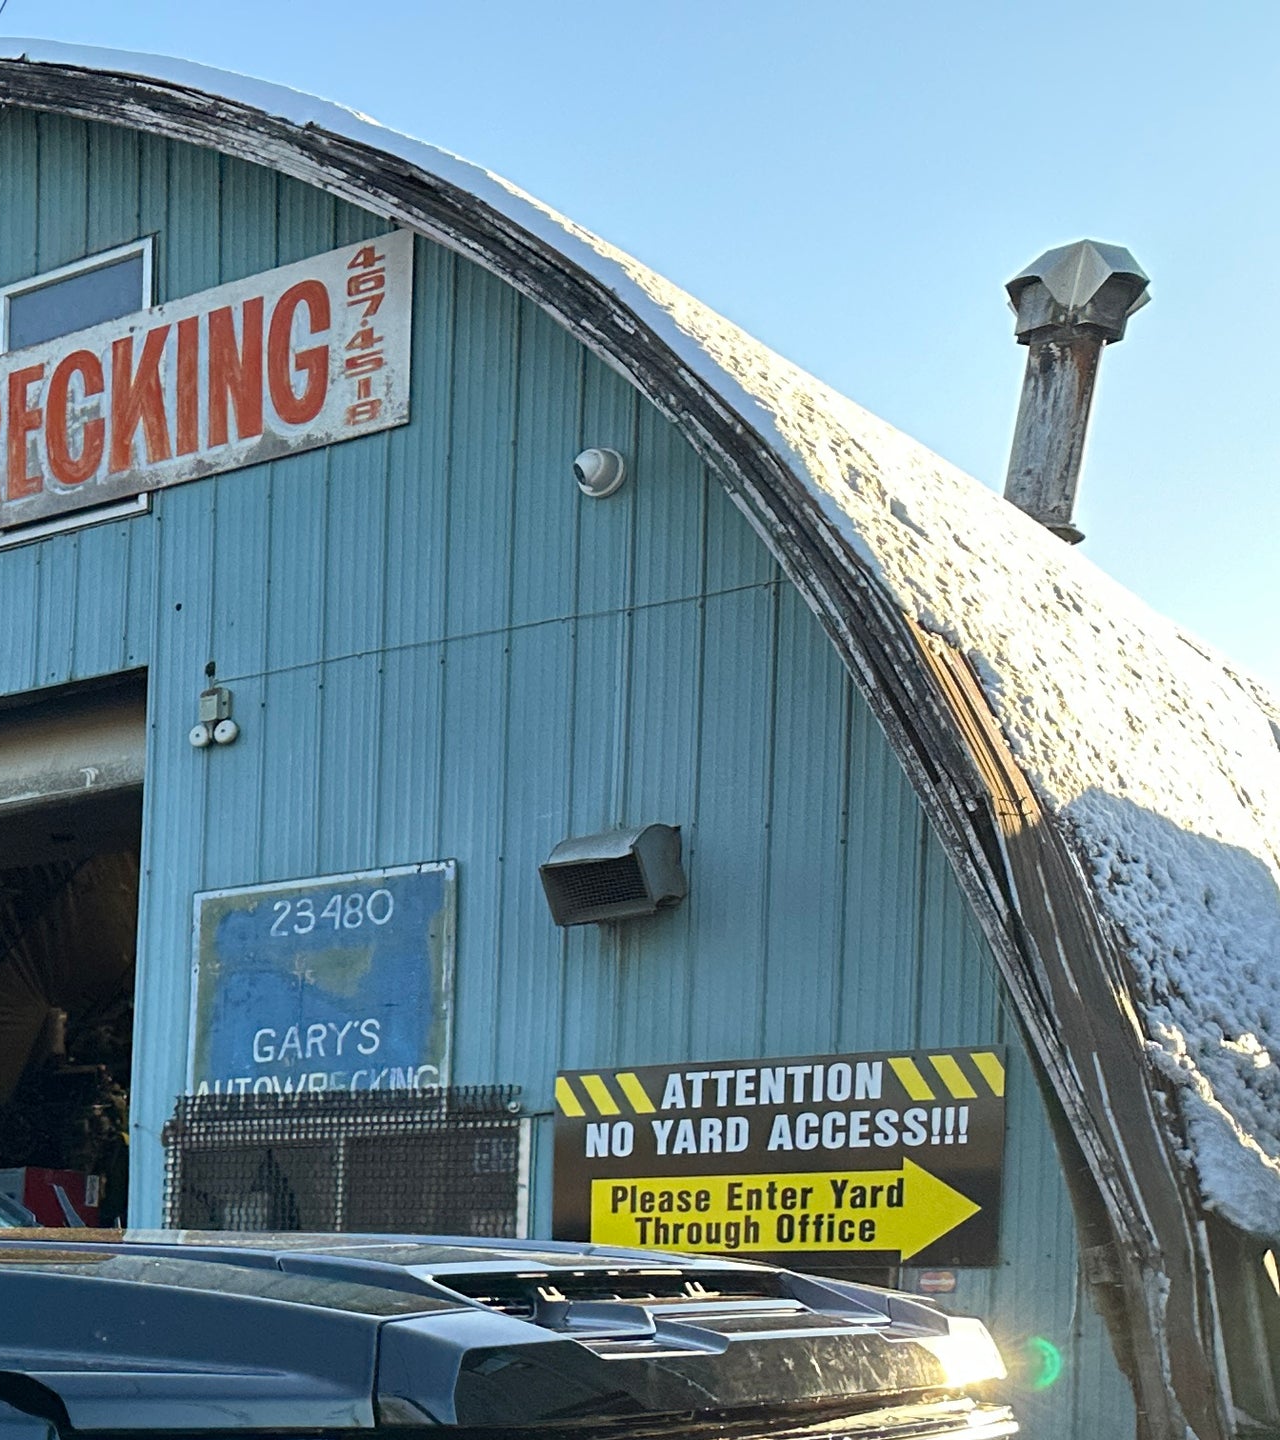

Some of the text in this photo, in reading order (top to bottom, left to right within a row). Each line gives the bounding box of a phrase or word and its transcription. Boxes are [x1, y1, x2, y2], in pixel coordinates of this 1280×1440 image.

[270, 889, 394, 937] 23480
[252, 1018, 381, 1063] GARY'S
[661, 1061, 883, 1110] ATTENTION
[585, 1106, 969, 1158] NO YARD ACCESS!!!
[611, 1177, 904, 1214] Please Enter Yard
[635, 1213, 876, 1249] Through Office
